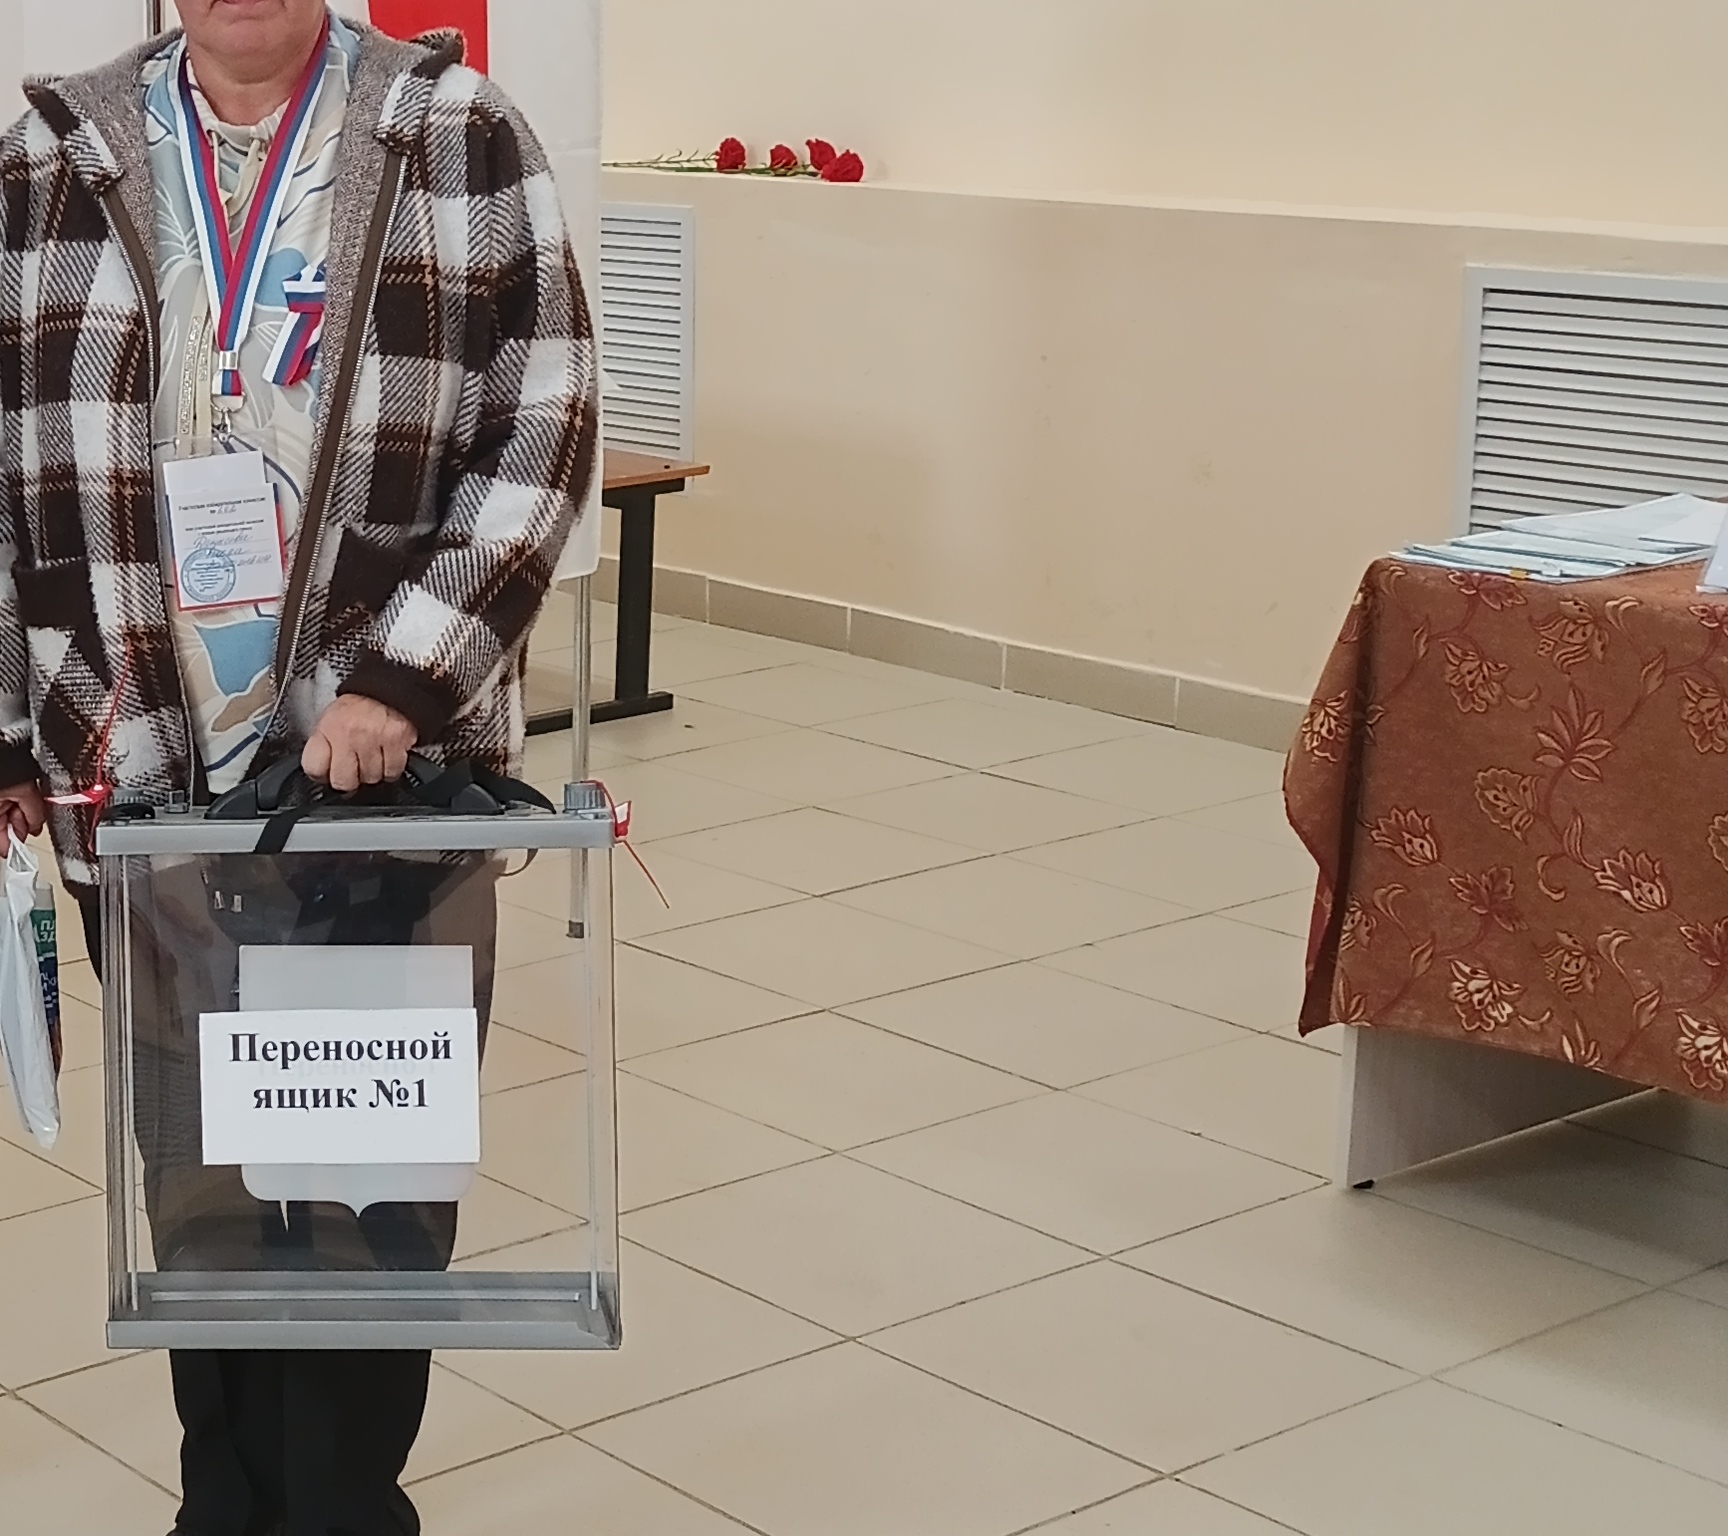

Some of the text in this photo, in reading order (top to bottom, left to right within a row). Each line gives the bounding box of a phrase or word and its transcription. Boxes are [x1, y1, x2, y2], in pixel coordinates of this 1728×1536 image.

[228, 1031, 453, 1069] Переносной
[253, 1078, 429, 1113] ящик №1
